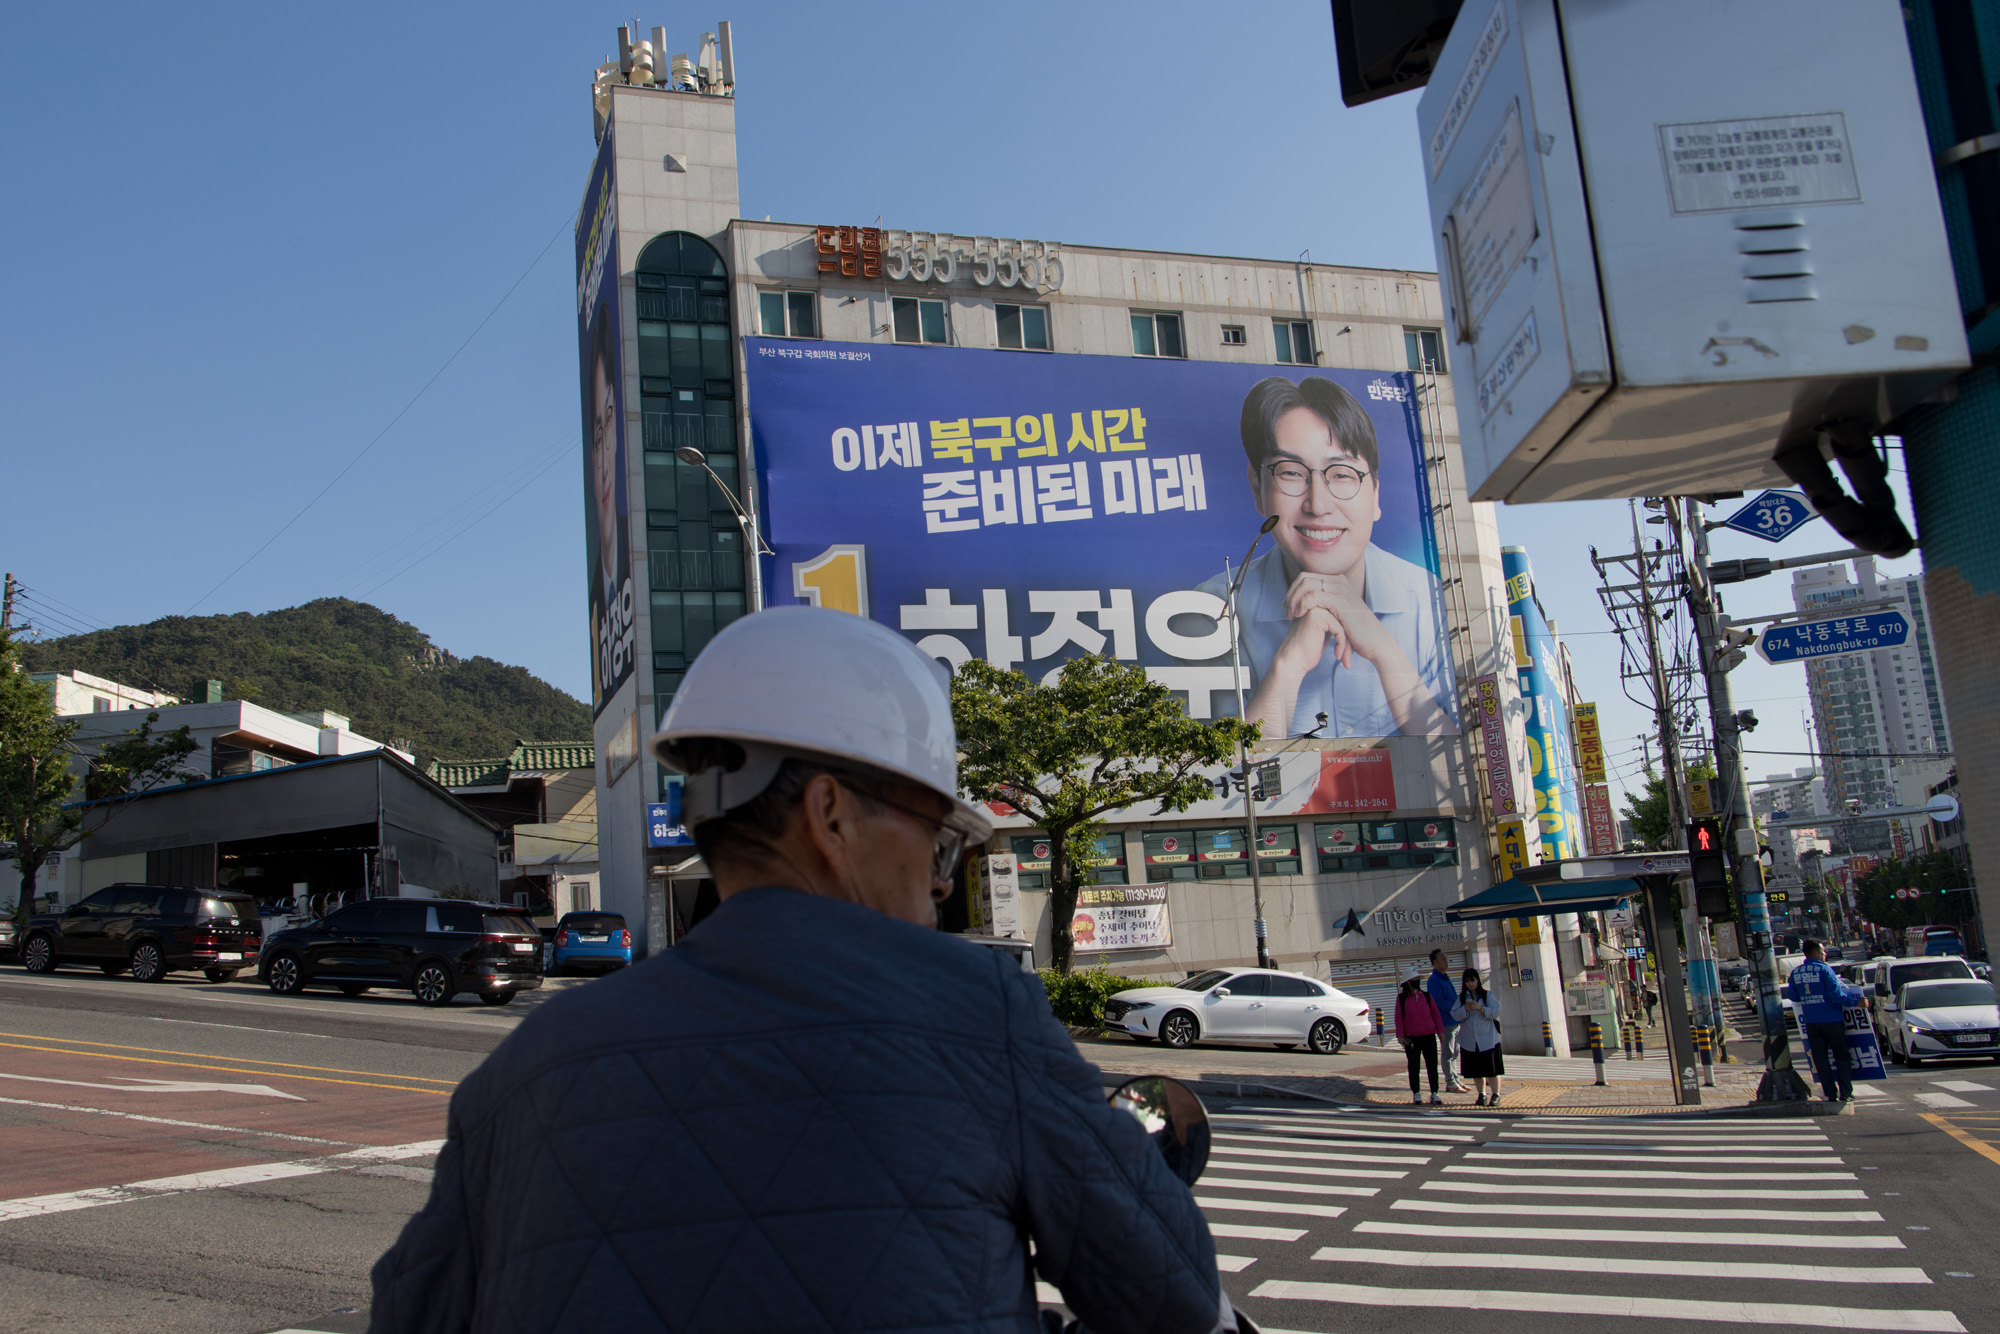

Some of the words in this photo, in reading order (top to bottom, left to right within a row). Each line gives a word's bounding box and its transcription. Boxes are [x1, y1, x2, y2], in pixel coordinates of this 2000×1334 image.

[887, 229, 1065, 291] 555-5555
[759, 346, 776, 358] 부산
[778, 348, 802, 359] 북구갑
[804, 349, 837, 360] 국회의원
[839, 351, 871, 361] 보궐선거
[1367, 385, 1407, 402] 민주당
[831, 421, 923, 472] 이제
[929, 413, 1059, 464] 북구의
[1066, 407, 1147, 454] 시간
[922, 461, 1093, 534] 준비된
[1099, 453, 1207, 516] 미래
[1756, 505, 1793, 529] 36
[1768, 638, 1790, 651] 674
[1796, 618, 1871, 643] 낙동북로
[1878, 622, 1902, 636] 670
[1796, 636, 1878, 657] Nakdongbuk-ro
[1579, 718, 1603, 772] 부동산
[1327, 754, 1383, 763] www.songdam.co.kr
[1485, 717, 1510, 798] 노래연습장
[1355, 798, 1389, 807] 342-2841
[652, 809, 667, 817] 민주
[1100, 889, 1125, 903] 주차가능
[1098, 910, 1115, 920] 송담
[1119, 908, 1147, 919] 갈비탕
[1099, 922, 1127, 933] 수제비
[1130, 920, 1156, 931] 추어탕
